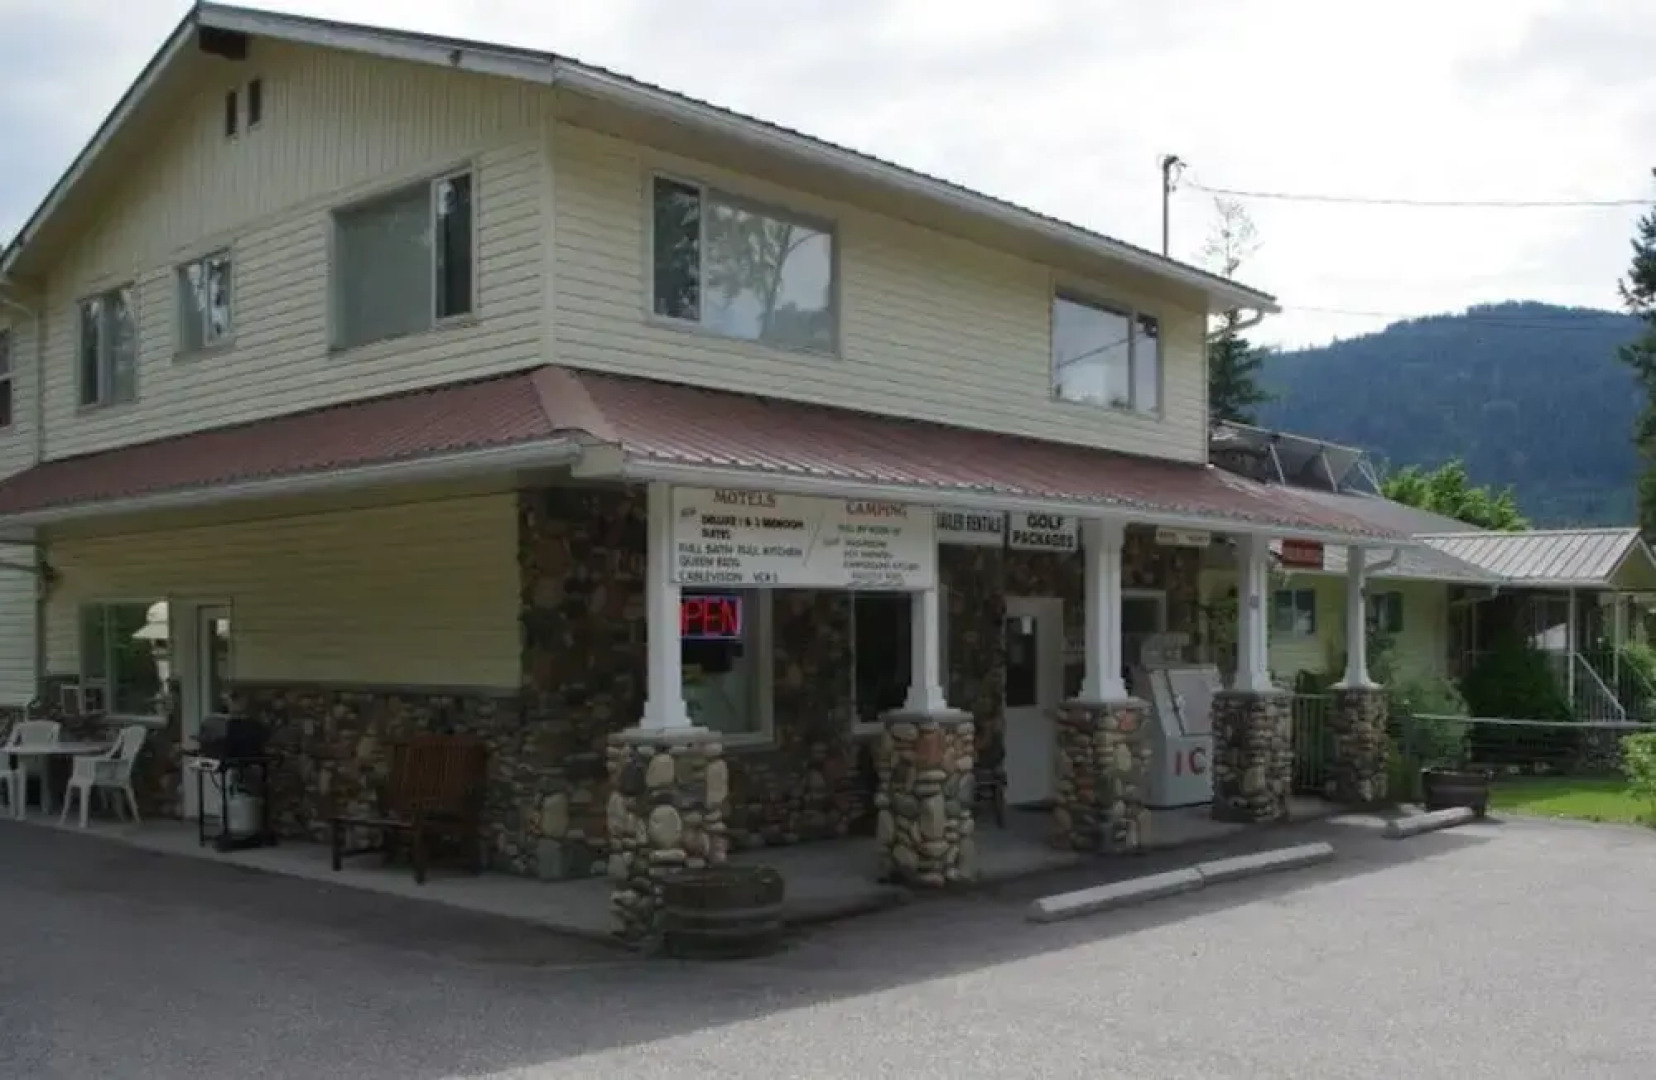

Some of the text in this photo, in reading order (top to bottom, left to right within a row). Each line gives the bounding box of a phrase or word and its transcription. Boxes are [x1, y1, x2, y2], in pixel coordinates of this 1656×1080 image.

[714, 489, 776, 508] MOTELS
[845, 502, 908, 519] CAMPING
[966, 513, 1002, 533] RENTALS
[1026, 512, 1063, 531] GOLF
[1011, 530, 1074, 548] PACKAGES
[678, 543, 702, 554] FULL
[706, 544, 733, 555] BATH
[763, 546, 803, 557] KITCHEN
[678, 554, 714, 568] QUEEN
[679, 571, 743, 583] CABLEVISION
[680, 597, 742, 637] PEN
[1174, 747, 1207, 777] IC
